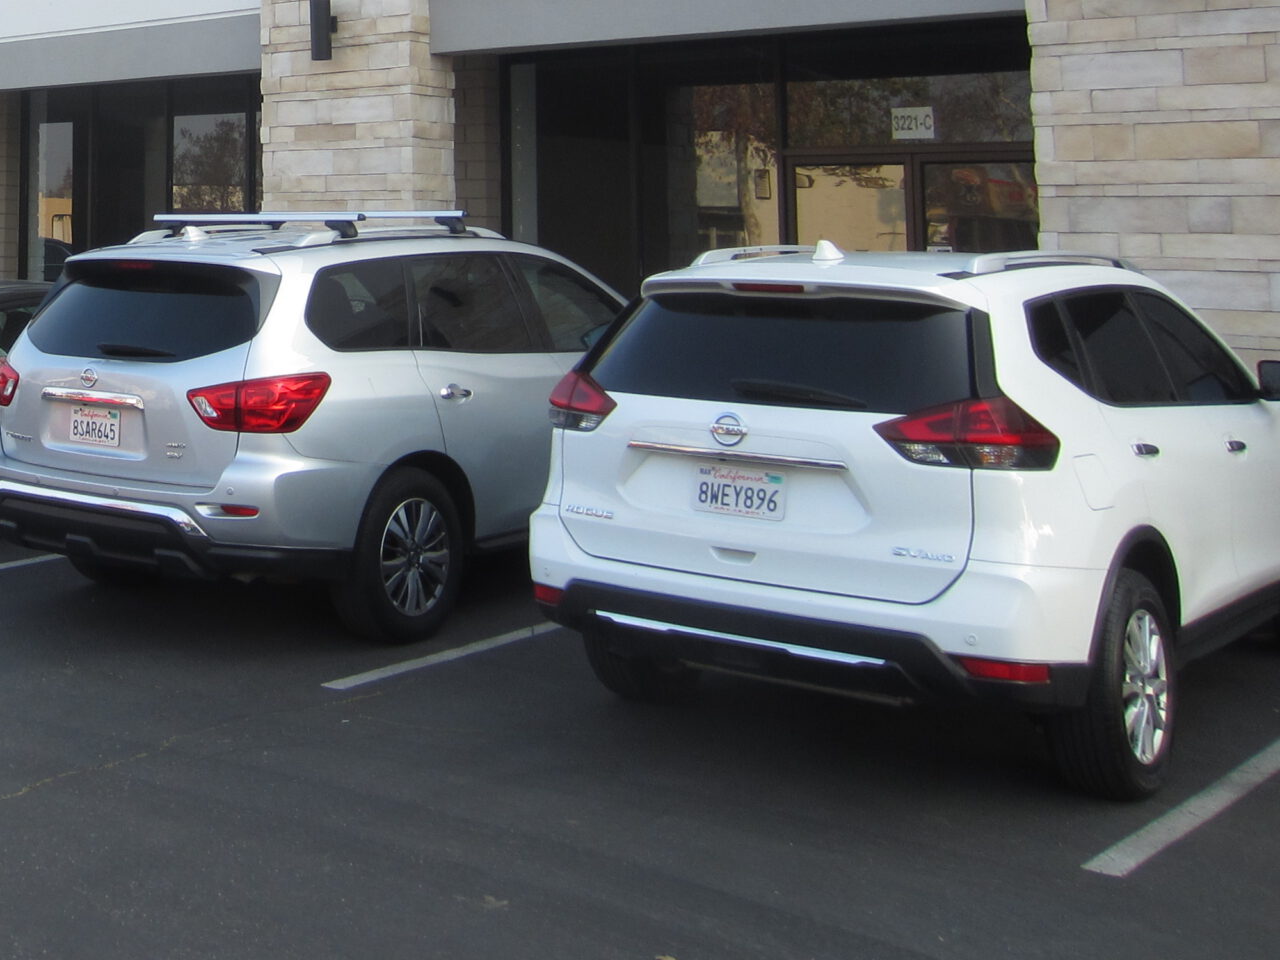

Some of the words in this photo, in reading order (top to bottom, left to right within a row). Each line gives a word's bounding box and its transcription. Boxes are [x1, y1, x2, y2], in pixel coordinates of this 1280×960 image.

[893, 114, 932, 131] 3221-C
[73, 419, 116, 440] 8SAR645
[713, 468, 768, 484] California
[698, 481, 779, 512] 8WEY896
